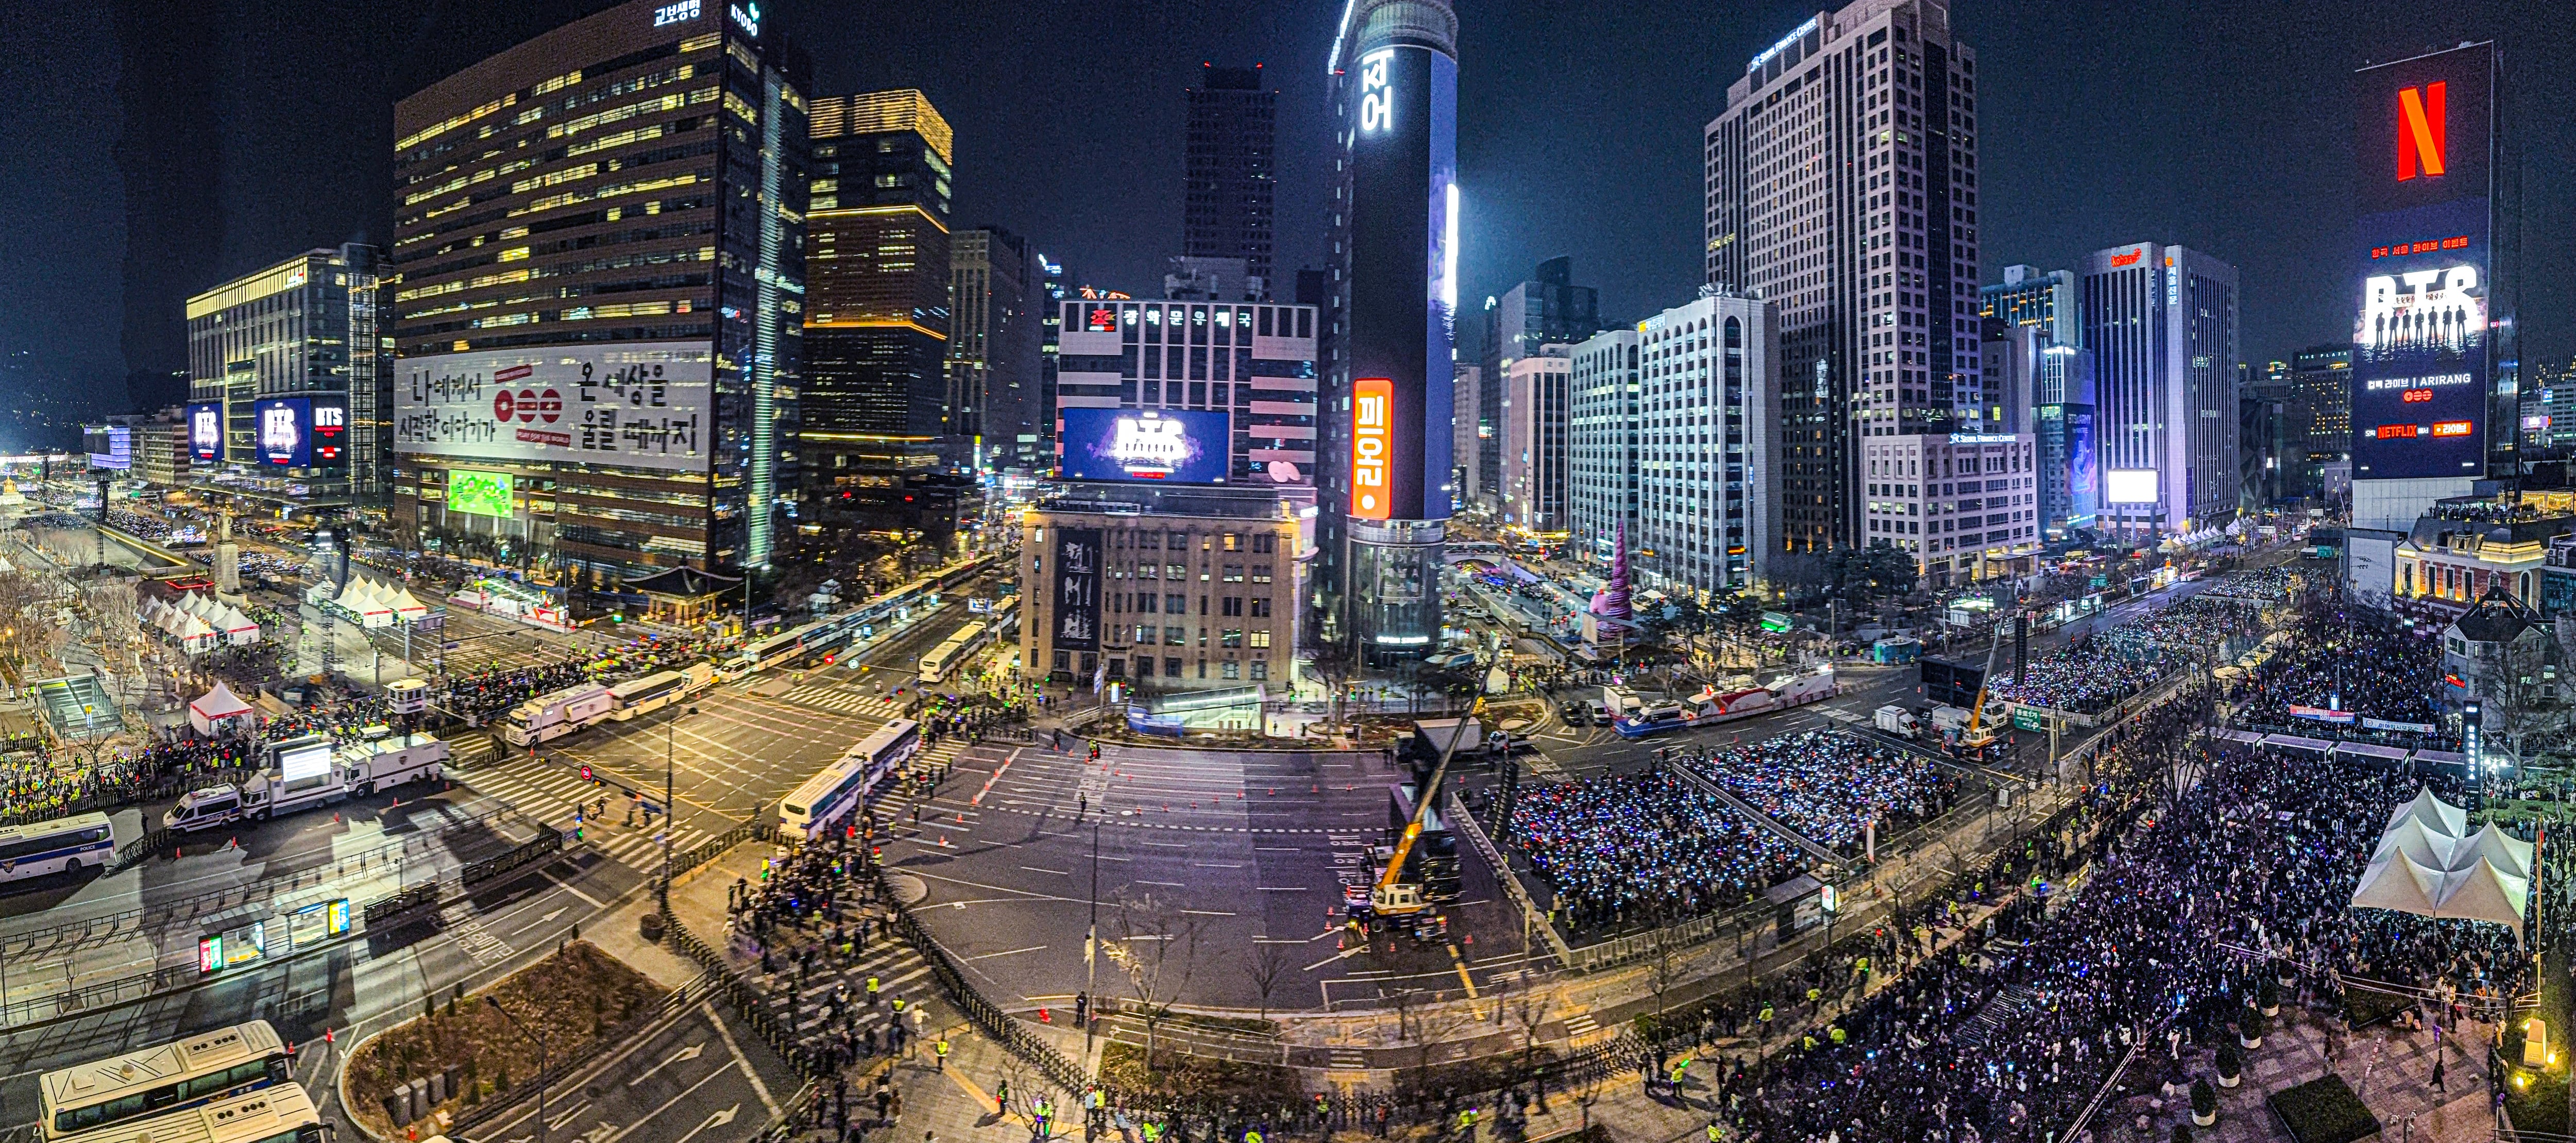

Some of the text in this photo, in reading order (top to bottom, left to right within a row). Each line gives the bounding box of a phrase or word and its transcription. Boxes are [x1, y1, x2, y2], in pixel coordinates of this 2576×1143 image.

[654, 0, 700, 26] 교보생명
[731, 4, 758, 37] KYOBO
[2398, 80, 2446, 181] N
[2372, 238, 2467, 258] 한국 서울 라이브 이벤트
[2168, 266, 2177, 305] 서울신문
[1123, 310, 1251, 327] 광화문우체국
[2364, 265, 2478, 344] BTS
[413, 369, 481, 407] 나에게서
[577, 362, 598, 401] 온
[602, 363, 669, 407] 세상을
[2368, 378, 2409, 389] 컴백 라이브
[2420, 374, 2471, 386] ARIRANG
[315, 407, 342, 426] BTS
[399, 409, 496, 443] 시작한 이야기가
[2443, 424, 2467, 433] 라이브
[580, 409, 698, 456] 울릴 때까지
[1357, 395, 1384, 486] 라이브
[2378, 425, 2417, 439] NETFLIX
[2016, 709, 2038, 719] 종로1가
